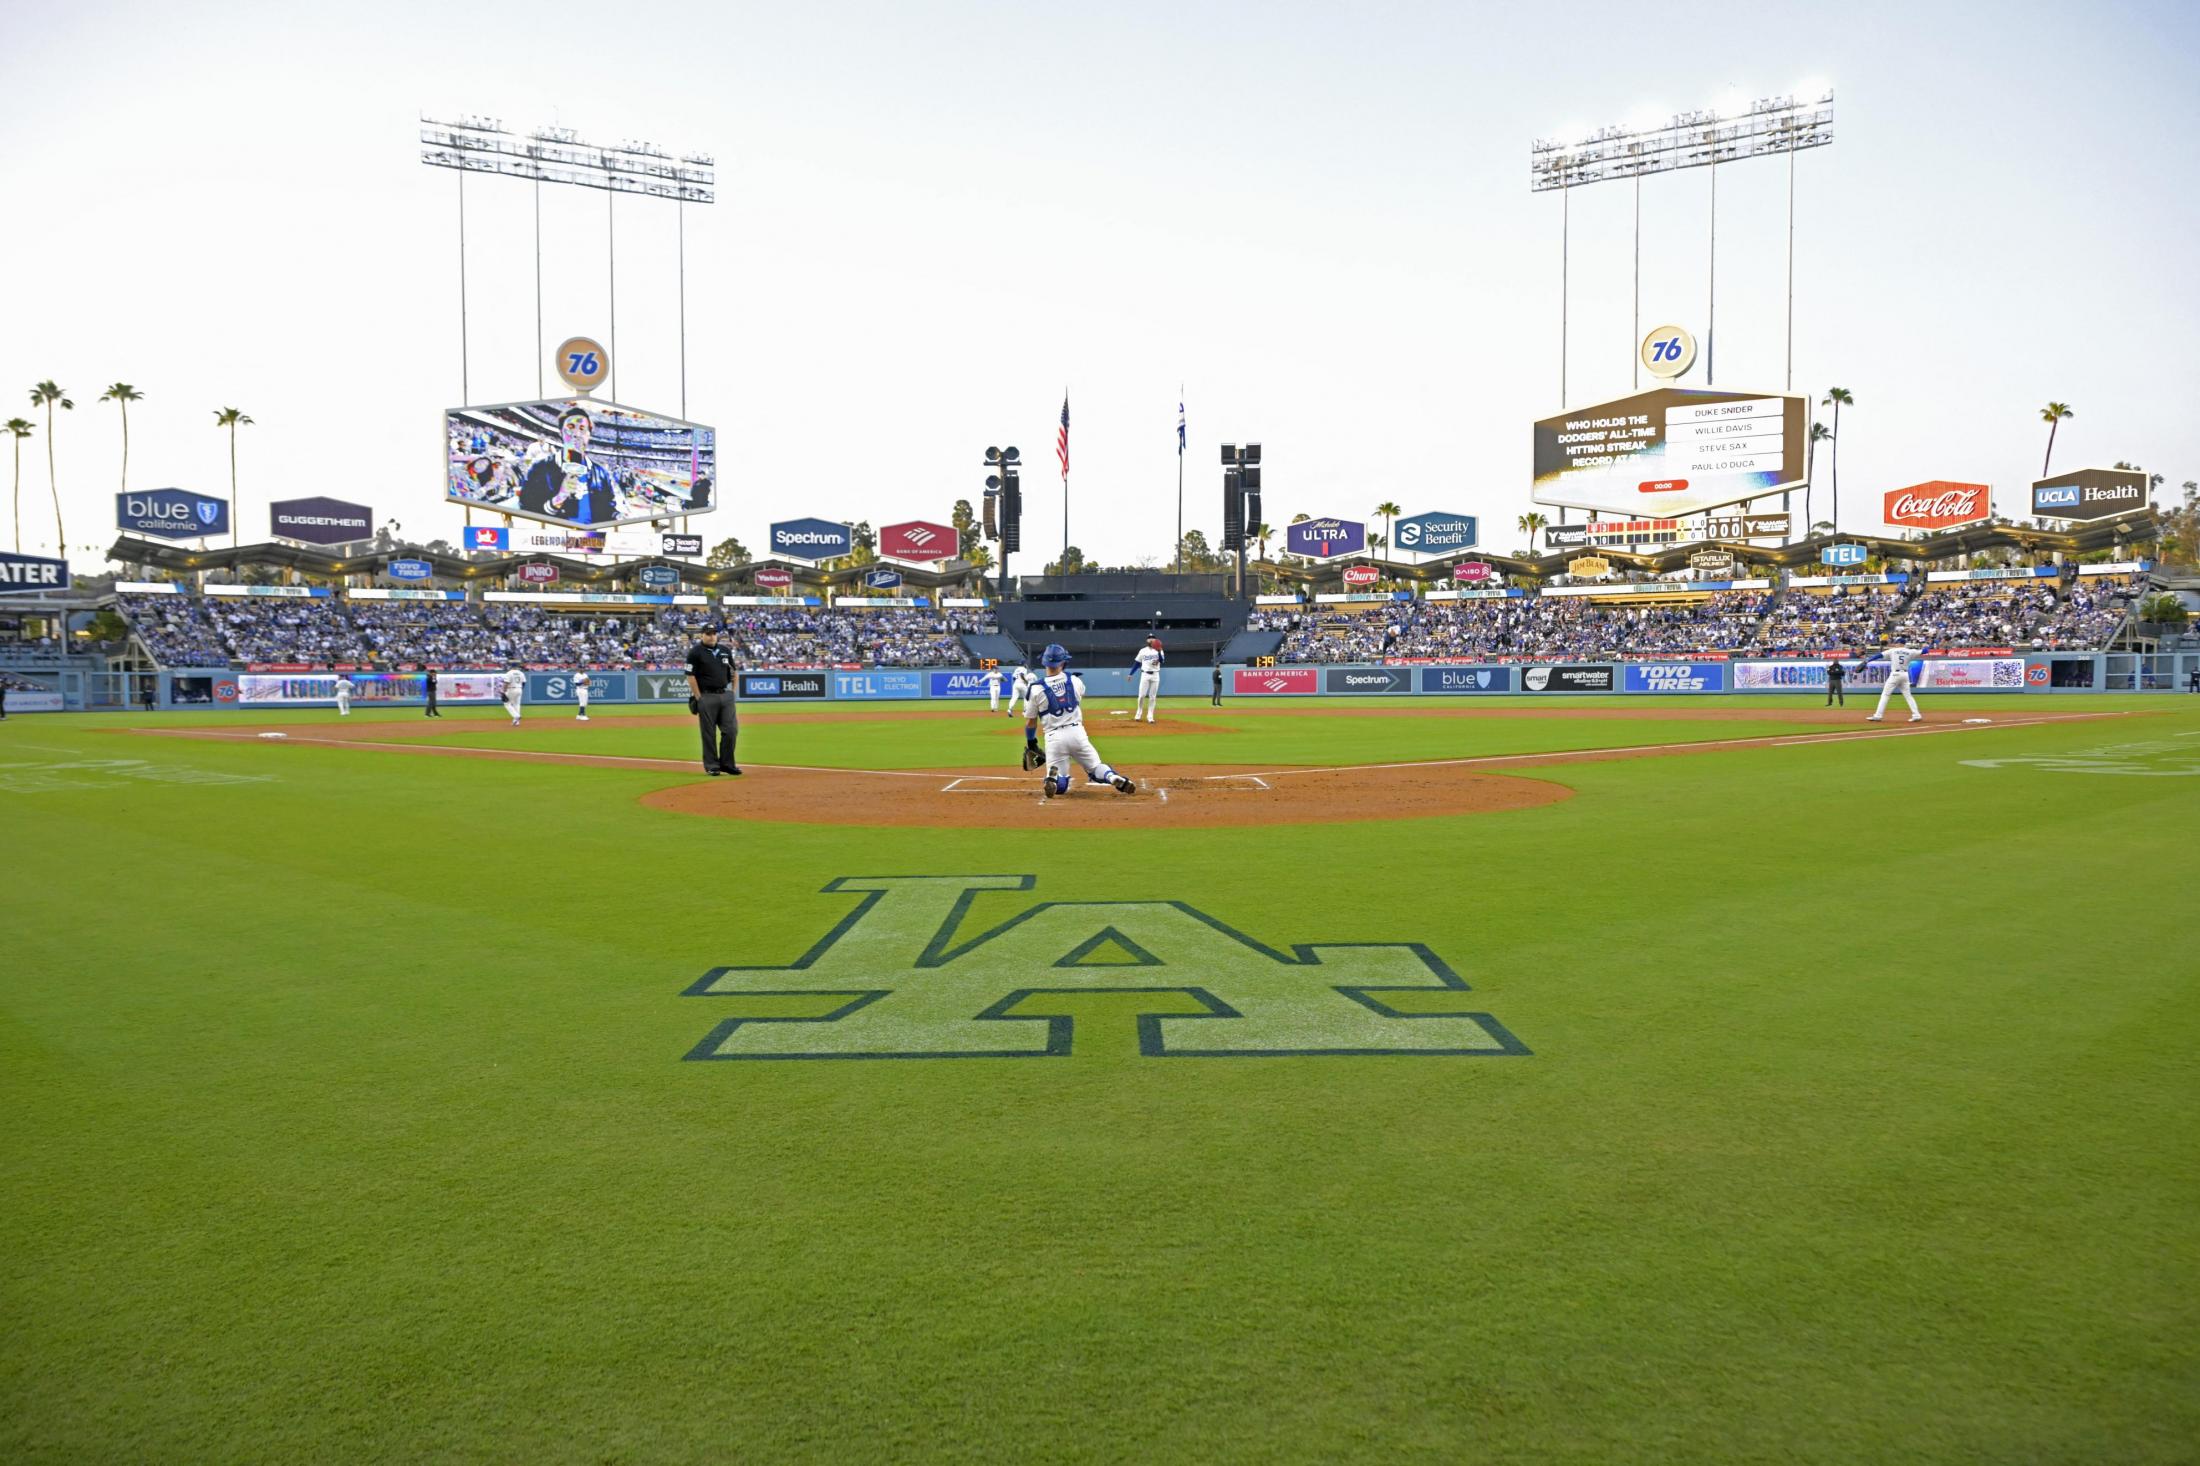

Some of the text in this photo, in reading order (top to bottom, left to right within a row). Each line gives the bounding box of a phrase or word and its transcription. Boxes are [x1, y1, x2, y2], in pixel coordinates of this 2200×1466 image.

[1652, 337, 1682, 362] 76
[568, 353, 598, 375] 76
[1695, 405, 1753, 417] DUKE SNIDER
[1566, 415, 1648, 430] WHO HOLDS THE
[1558, 427, 1656, 443] DODGERS' ALL-TIME
[1695, 424, 1752, 435] WILLIE DAVIS
[1566, 440, 1646, 455] HITTING STREAK
[1699, 442, 1747, 452] STEVE SAX
[1572, 456, 1612, 467] RECORD
[1691, 463, 1713, 471] PAUL
[1729, 460, 1755, 469] DUCA
[1654, 482, 1673, 490] 00:00
[2039, 484, 2139, 503] UCLA Health
[127, 495, 190, 519] blue
[1891, 488, 1981, 519] Coca-Cola
[137, 520, 198, 531] california
[278, 515, 366, 527] GUGGENHEIM
[1425, 521, 1470, 534] Security
[1709, 523, 1740, 538] 0 0 0
[776, 530, 841, 547] Spectrum
[1303, 529, 1348, 541] ULTRA
[1425, 533, 1464, 545] Benefit
[1693, 555, 1730, 563] STARLUX
[1827, 548, 1862, 562] TEL
[1572, 558, 1605, 573] JIM BEAM
[525, 566, 553, 578] JINRO
[757, 573, 791, 583] Yakult
[1344, 570, 1377, 581] Churu
[1256, 656, 1274, 668] 1:39
[1899, 656, 1904, 664] 5
[1442, 671, 1475, 684] blue
[1562, 671, 1609, 679] smartwater
[1639, 666, 1692, 678] TOYO
[2029, 670, 2047, 680] 76
[751, 680, 819, 691] UCLA Health
[838, 676, 877, 694] TEL
[947, 675, 979, 688] ANA
[1345, 675, 1388, 686] Spectrum
[1647, 677, 1705, 690] TIRES
[1936, 678, 1982, 686] Budweiser
[218, 686, 235, 697] 76
[570, 689, 605, 697] Befit
[679, 873, 1534, 1061] LA
